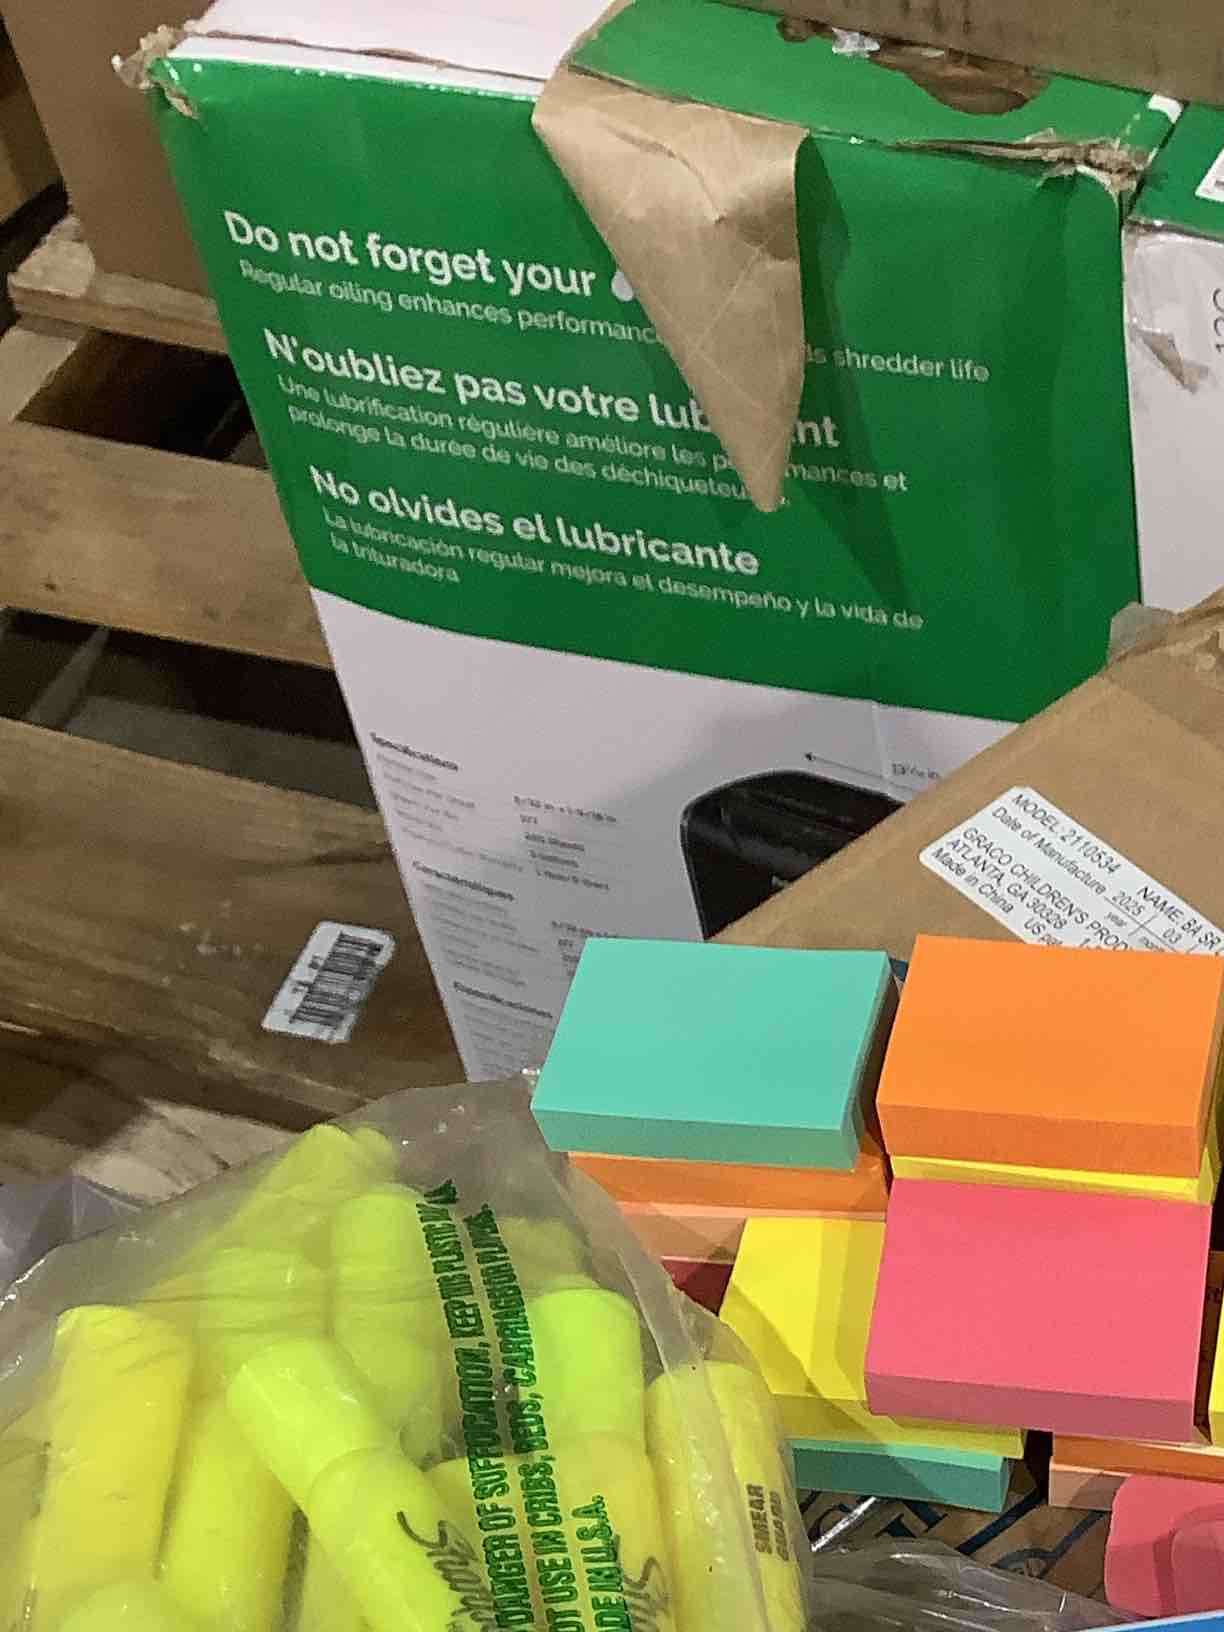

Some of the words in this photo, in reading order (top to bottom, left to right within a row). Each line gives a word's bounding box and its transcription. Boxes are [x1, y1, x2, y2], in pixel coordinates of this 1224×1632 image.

[224, 209, 280, 253] Do
[288, 229, 359, 266] not
[365, 232, 495, 287] forget
[502, 259, 596, 297] your
[240, 260, 322, 297] Regular
[329, 280, 392, 312] oiling
[398, 293, 512, 325] enhances
[264, 327, 448, 394] N'oubliez
[455, 372, 526, 407] pas
[533, 383, 640, 423] votre
[833, 347, 946, 381] shredder
[950, 358, 990, 384] life
[277, 375, 321, 403] Une
[324, 388, 453, 427] lubrification
[457, 413, 561, 447] régulière
[565, 431, 666, 462] améliore
[672, 444, 706, 467] les
[883, 470, 908, 492] et
[287, 404, 381, 445] prolonge
[383, 426, 406, 449] la
[410, 433, 477, 460] durée
[481, 443, 512, 467] de
[515, 450, 549, 472] vie
[554, 454, 597, 481] des
[309, 464, 361, 506] No
[368, 487, 505, 537] olvides
[512, 512, 553, 544] el
[556, 515, 760, 577] lubricante
[330, 531, 349, 554] la
[351, 535, 461, 585] trituradora
[322, 504, 348, 530] La
[350, 514, 464, 559] lubricación
[468, 547, 546, 576] regular
[550, 558, 626, 589] mejora
[631, 573, 655, 593] el
[657, 576, 792, 614] desempeño
[797, 600, 809, 621] y
[814, 598, 837, 620] la
[841, 603, 888, 627] vida
[892, 610, 925, 631] de
[931, 847, 968, 879] Made
[964, 872, 980, 888] in
[978, 881, 1015, 915] China
[1023, 916, 1047, 937] US
[962, 826, 1014, 867] GRACO
[1010, 862, 1090, 925] CHILDREN'S
[991, 805, 1023, 833] Date
[1020, 826, 1039, 844] of
[1034, 835, 1108, 897] Manufacture
[1111, 889, 1147, 918] 2025
[1162, 927, 1183, 946] 03
[1006, 881, 1029, 903] GA
[1026, 897, 1069, 931] 30328
[1060, 828, 1122, 875] 2110534
[1136, 885, 1185, 926] NAME:
[1181, 917, 1205, 938] BA
[443, 1300, 485, 1339] KEEP
[475, 1502, 516, 1533] OF
[530, 1529, 569, 1555] IN
[745, 1483, 773, 1554] SMEAR
[482, 1533, 535, 1629] DANGER
[535, 1556, 579, 1605] USE
[584, 1566, 625, 1594] IN
